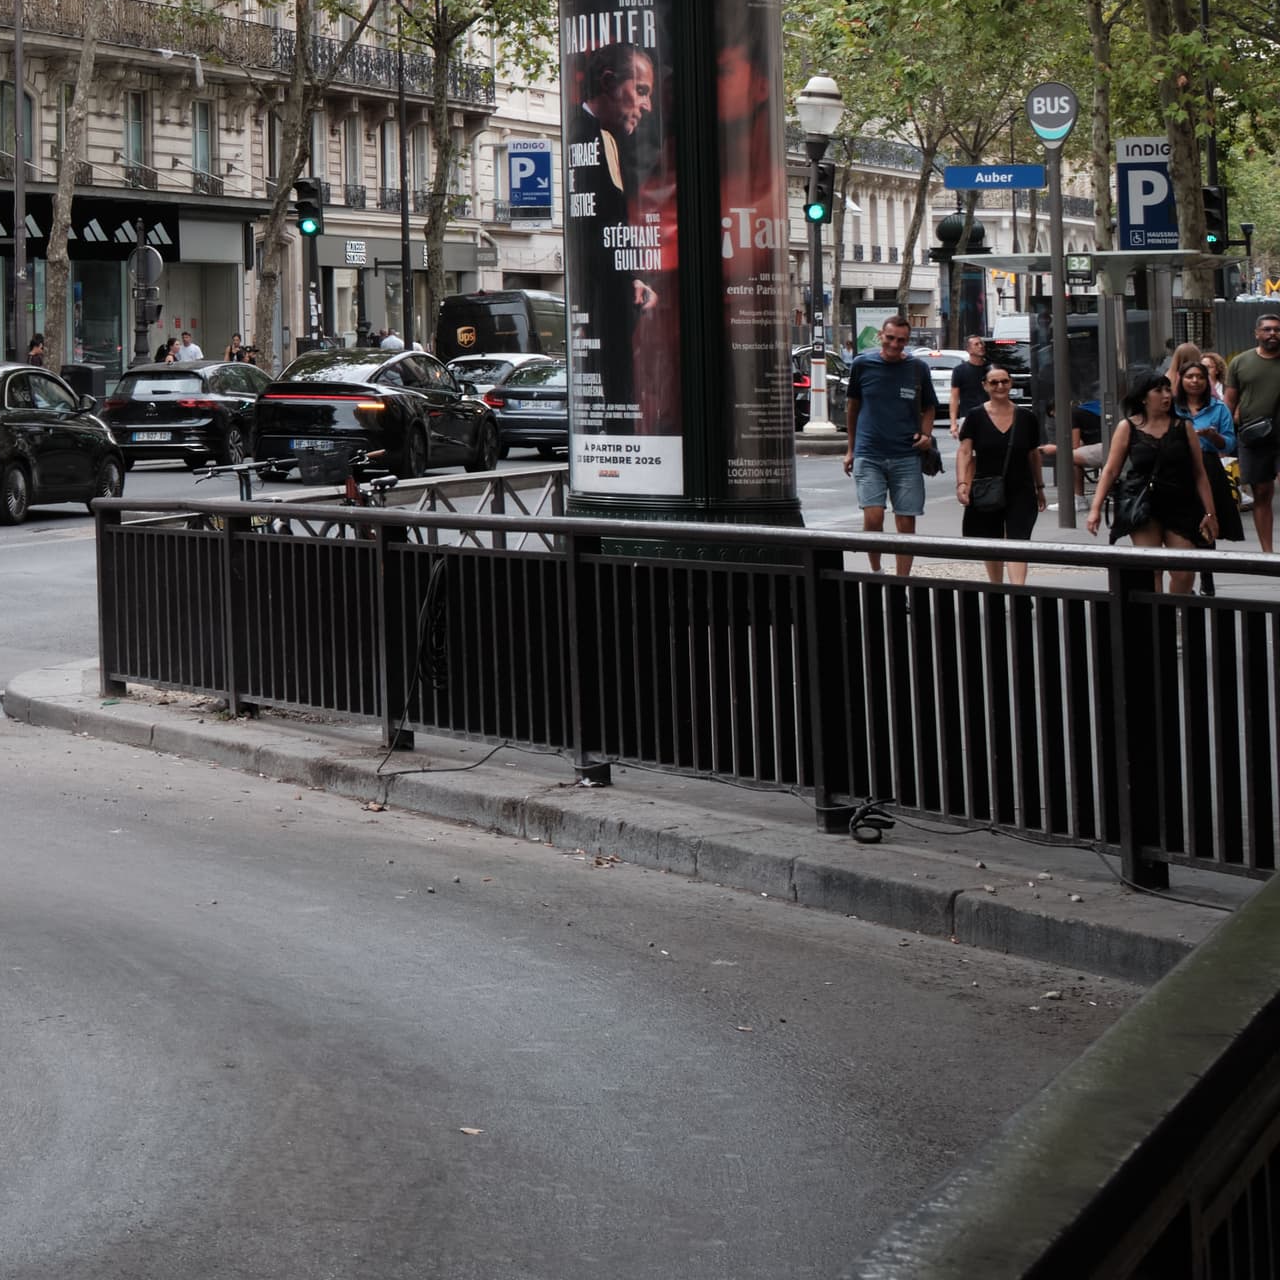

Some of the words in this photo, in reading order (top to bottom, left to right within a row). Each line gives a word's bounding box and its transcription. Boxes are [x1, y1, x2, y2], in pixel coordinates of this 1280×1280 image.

[1033, 96, 1070, 114] BUS
[512, 142, 545, 150] INDIGO
[1126, 143, 1173, 157] INDIG
[511, 156, 536, 189] P
[975, 172, 1014, 184] Auber
[1127, 169, 1169, 225] P
[603, 222, 661, 248] STÉPHANE
[1147, 237, 1179, 245] PRINTEMP
[614, 249, 662, 271] GUILLON
[1070, 256, 1090, 270] 32
[726, 284, 754, 295] entre
[458, 331, 476, 345] ups
[591, 444, 622, 453] PARTIR
[625, 444, 641, 453] DU
[583, 455, 632, 465] SEPTEMBRE
